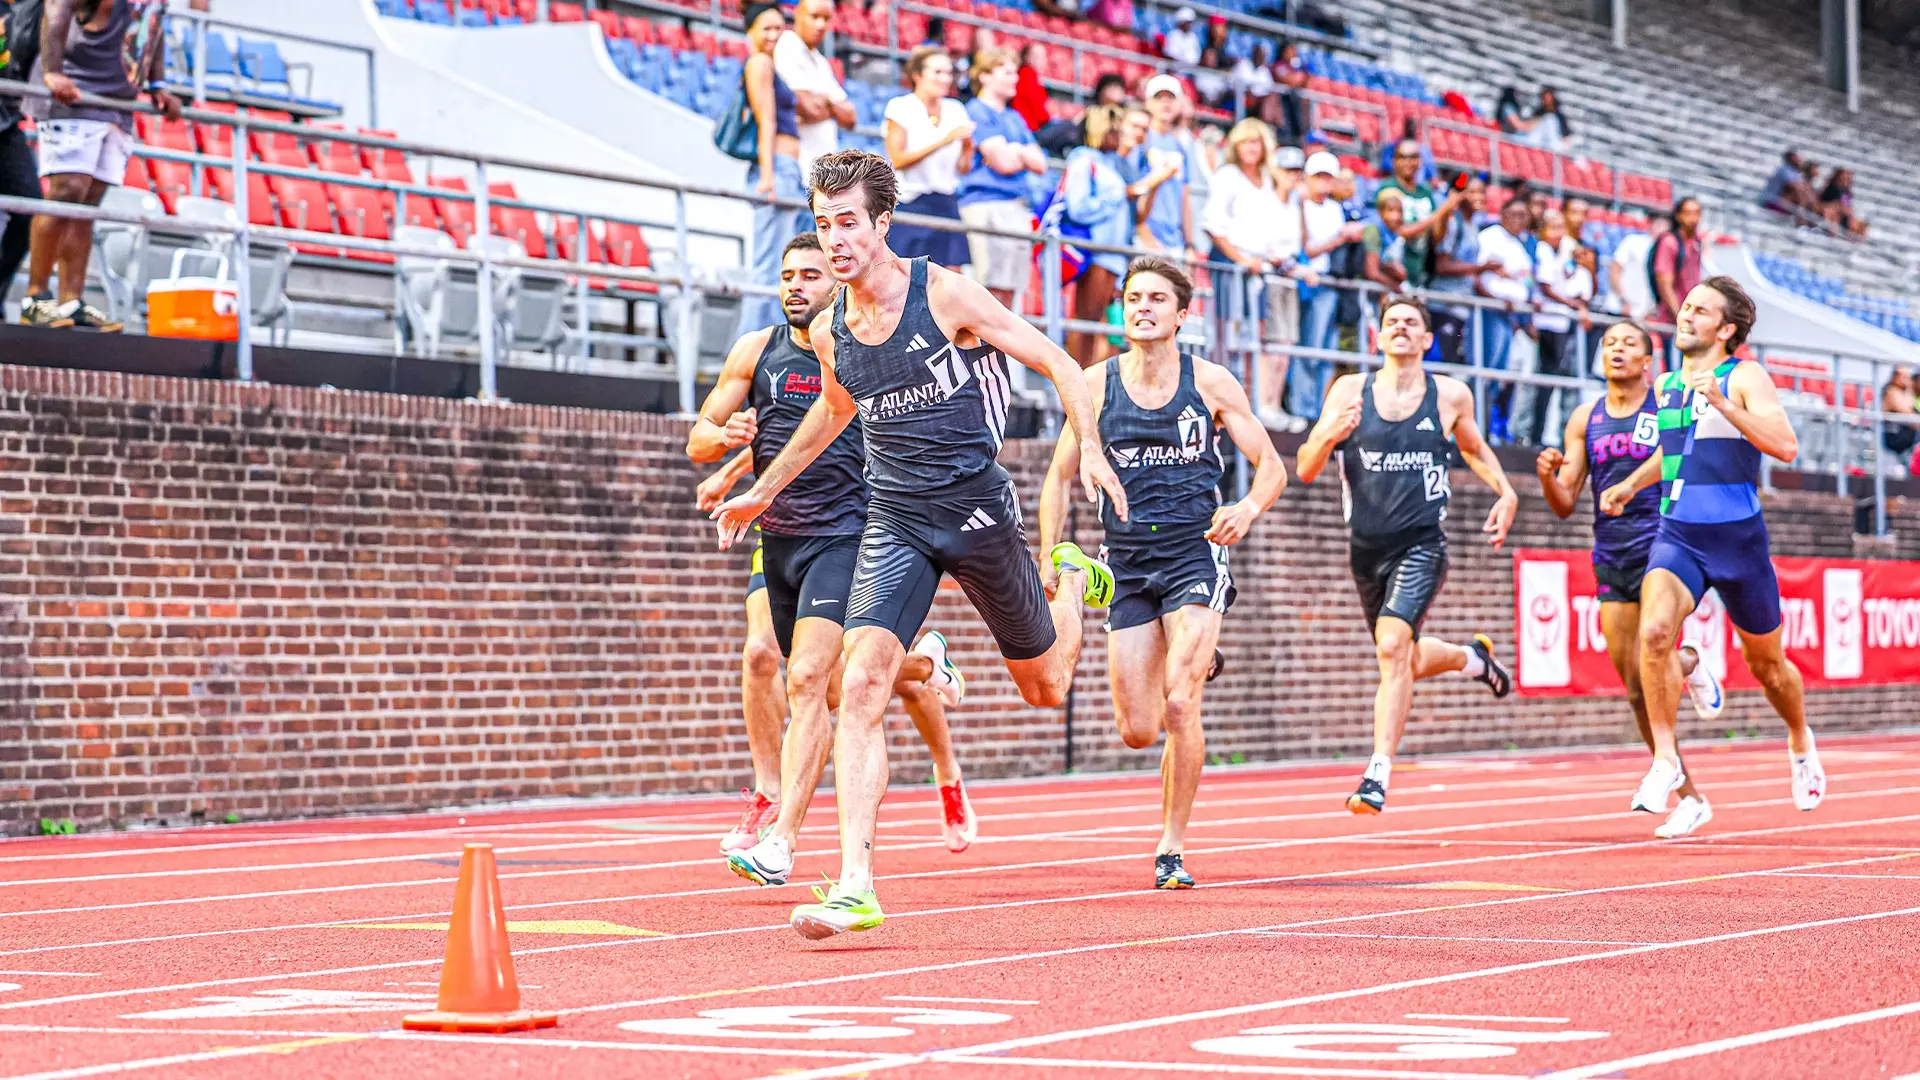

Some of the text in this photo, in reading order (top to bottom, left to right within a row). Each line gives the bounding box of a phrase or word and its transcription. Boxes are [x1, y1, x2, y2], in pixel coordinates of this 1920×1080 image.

[931, 347, 960, 390] 7
[881, 404, 914, 419] TRACK
[1186, 420, 1202, 452] 4
[1638, 417, 1659, 440] 5
[1142, 458, 1174, 466] TRACK
[1383, 451, 1433, 466] ATLANTA
[1428, 470, 1439, 496] 2
[1863, 597, 1920, 648] TOYO
